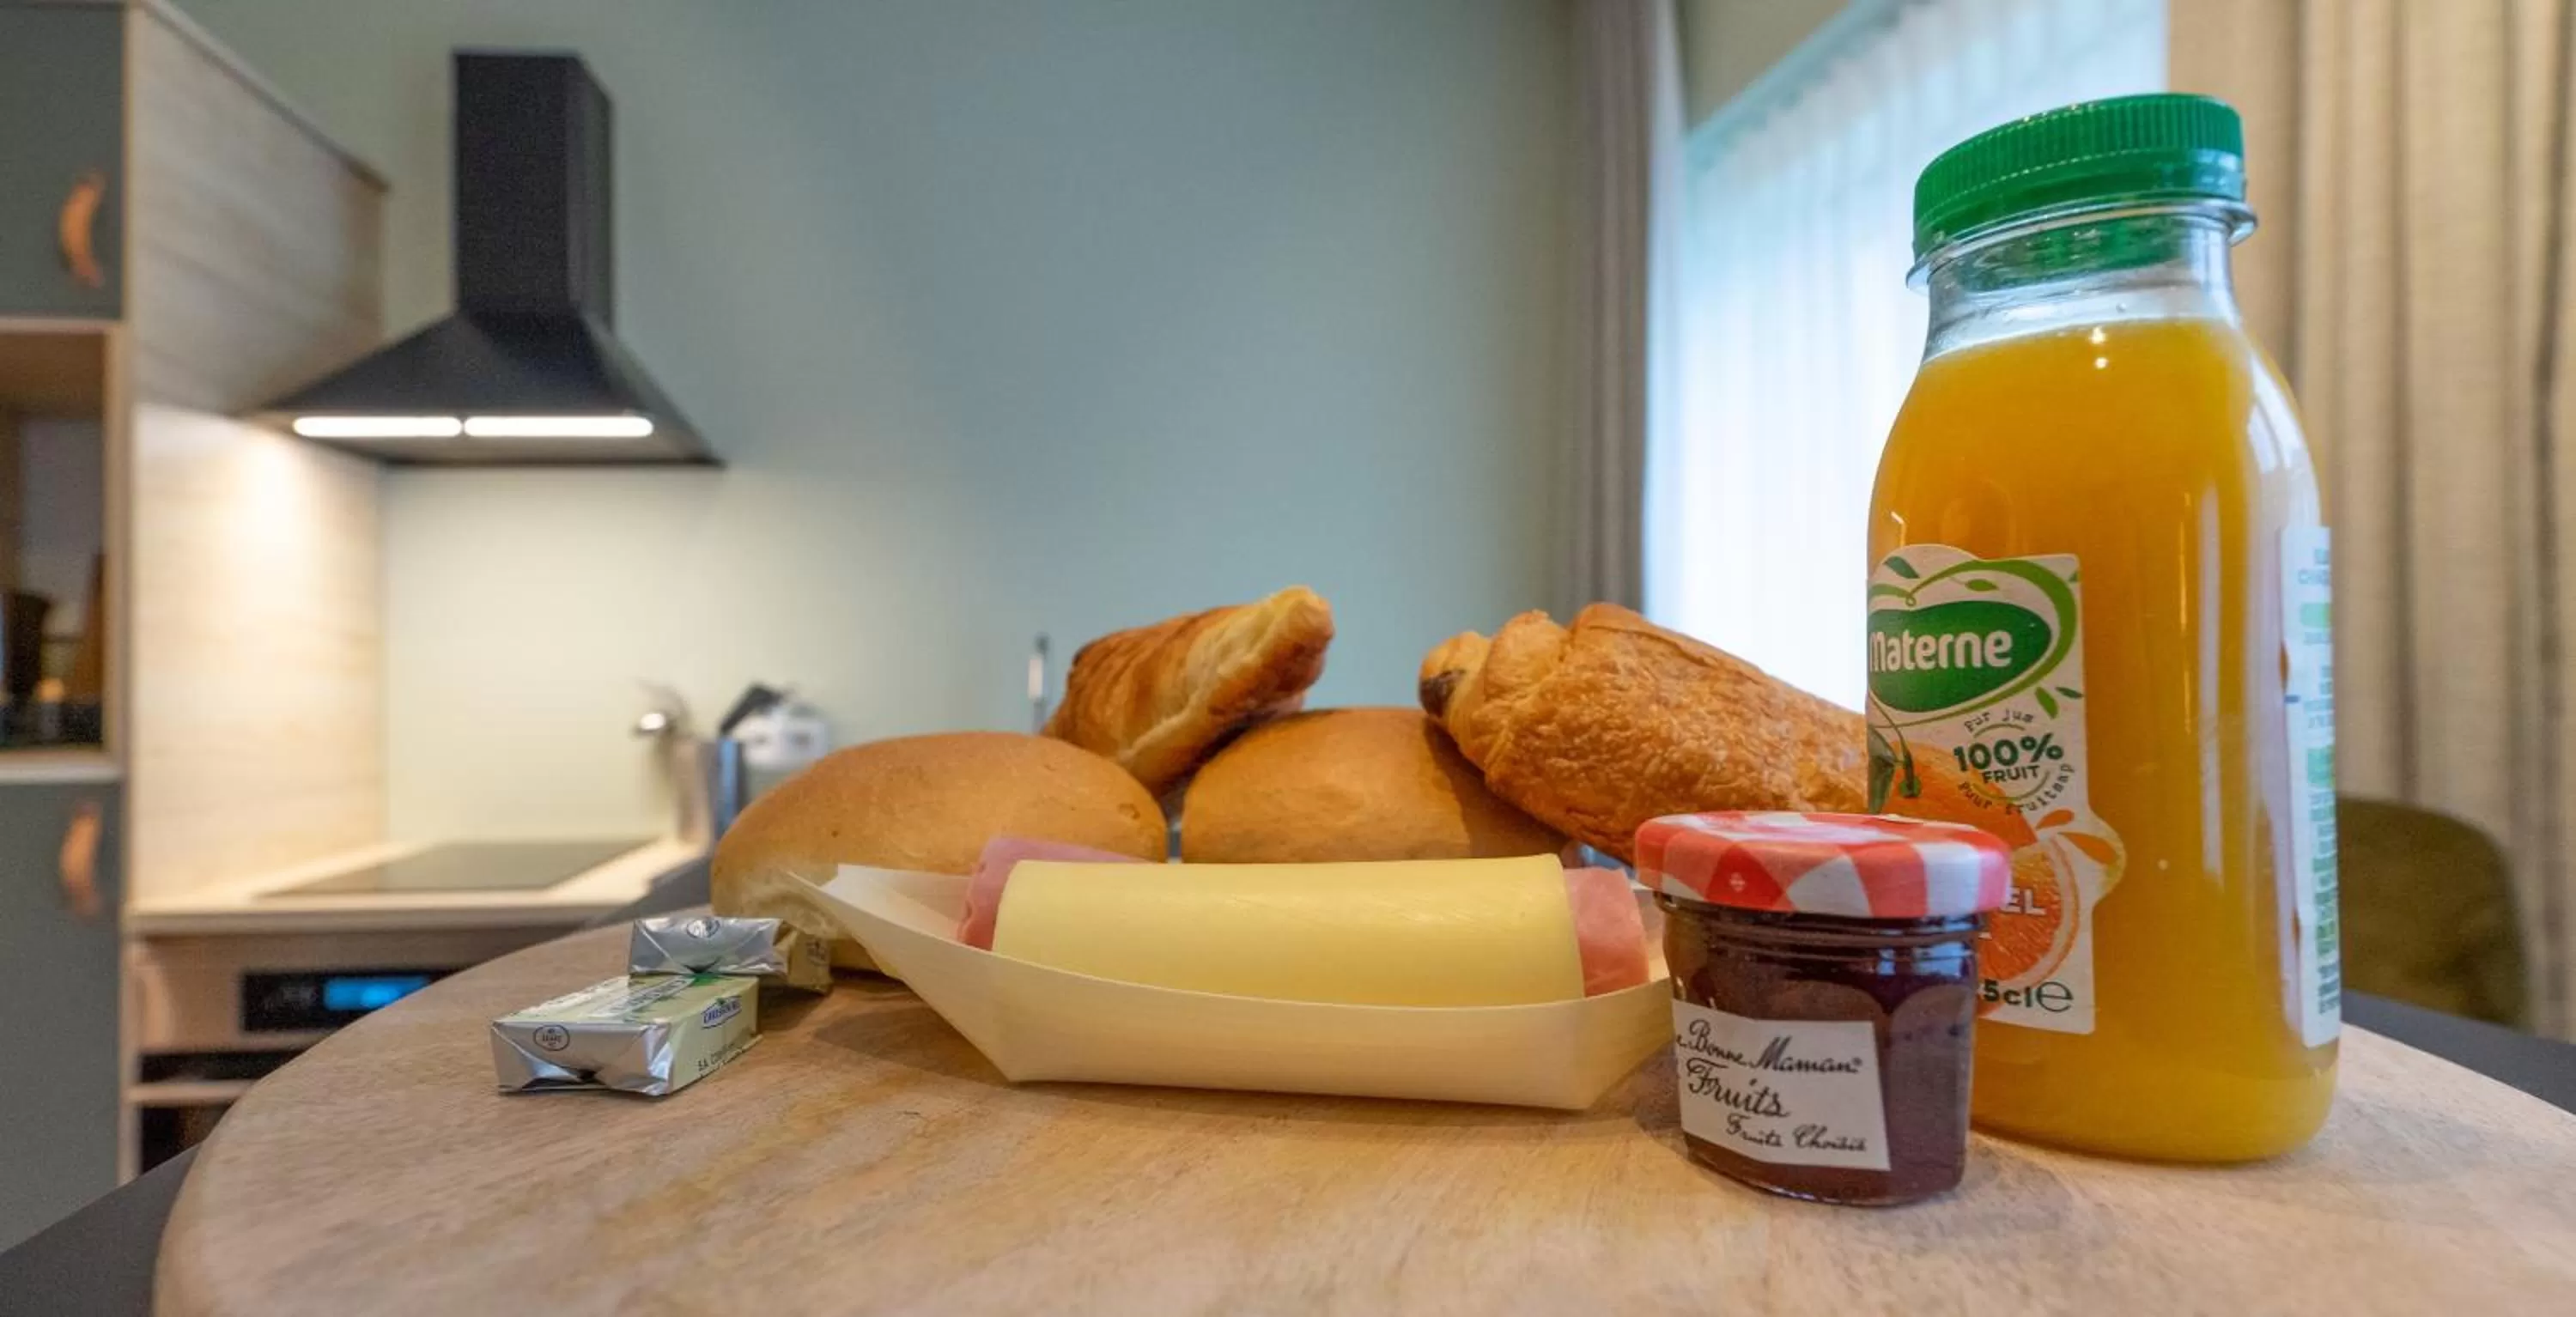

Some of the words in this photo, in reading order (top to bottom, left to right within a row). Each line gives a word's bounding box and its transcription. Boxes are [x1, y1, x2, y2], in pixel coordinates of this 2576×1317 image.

[1869, 629, 2013, 672] Materne
[1953, 732, 2064, 772] 100%
[1982, 765, 2040, 784] FRUIT
[1688, 1019, 1747, 1066] Bonne
[1686, 1057, 1790, 1117] Fruits
[1726, 1113, 1783, 1147] Fruits
